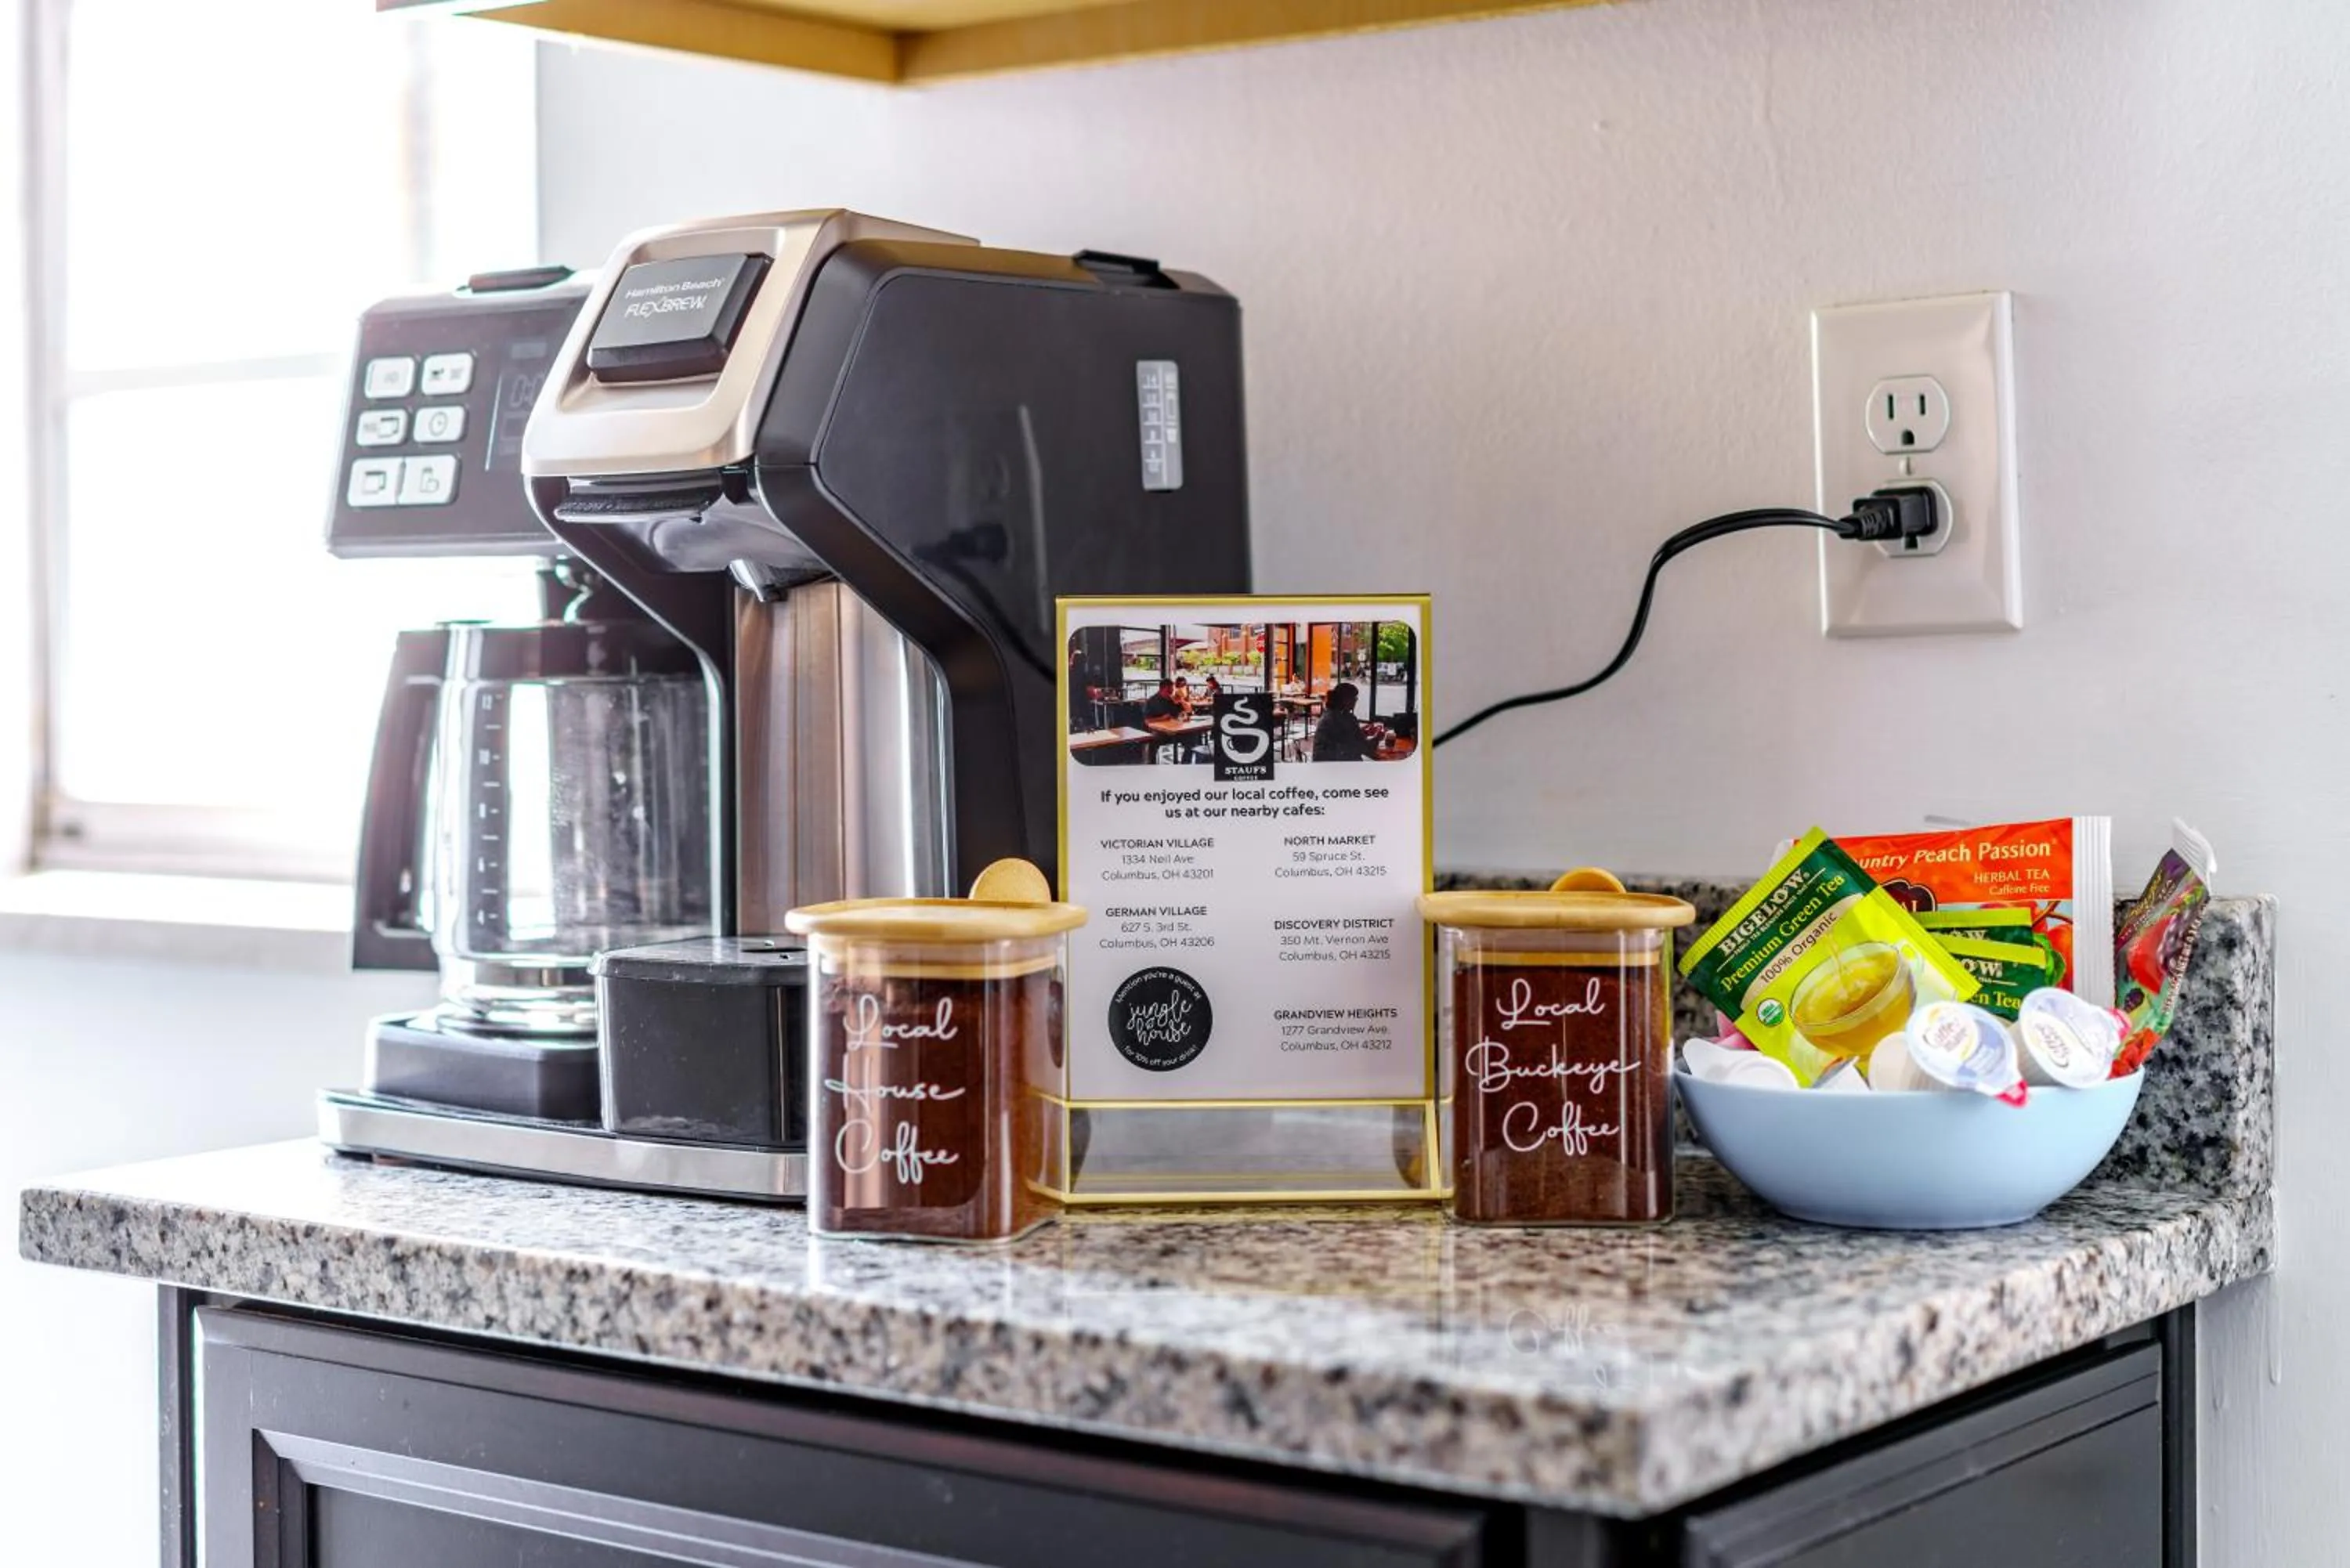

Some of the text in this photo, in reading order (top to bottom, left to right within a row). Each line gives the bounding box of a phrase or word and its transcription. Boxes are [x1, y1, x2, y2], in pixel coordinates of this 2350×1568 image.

[625, 276, 722, 298] Hamilton Beach
[1101, 786, 1390, 805] If you enjoyed our local coffee, come see
[1165, 803, 1325, 820] us at our nearby cafes:
[1101, 837, 1215, 850] VICTORIAN VILLAGE
[1284, 835, 1376, 846] NORTH MARKET
[1123, 854, 1195, 865] 1334 Neil Ave
[1292, 851, 1365, 863] 59 Spruce St.
[1914, 839, 1971, 865] Peach
[1978, 839, 2051, 861] Passion
[1101, 869, 1214, 881] Columbus, OH 43201
[1274, 865, 1387, 877] Columbus, OH 43215
[1974, 868, 2050, 884] HERBAL TEA
[1989, 882, 2050, 896] Caffeine Free
[1105, 906, 1208, 917] GERMAN VILLAGE
[1717, 867, 1808, 958] BIGELOW
[1121, 922, 1141, 933] 627
[1156, 922, 1174, 932] 3rd
[1177, 922, 1192, 931] St.
[1274, 918, 1395, 930] DISCOVERY DISTRICT
[1281, 935, 1301, 945] 350
[1303, 935, 1323, 945] Mt.
[1325, 935, 1365, 945] Vernon
[1721, 935, 1784, 992] Premium
[1778, 897, 1823, 938] Green
[1817, 874, 1846, 898] Tea
[1099, 936, 1215, 949] Columbus, OH 43206
[1762, 955, 1793, 985] 100%
[1791, 911, 1838, 958] Organic
[1279, 948, 1391, 962] Columbus, OH 43215
[1495, 977, 1606, 1031] Local
[1993, 991, 2020, 1009] Tea
[1126, 989, 1193, 1030] jungle
[1274, 1008, 1398, 1020] GRANDVIEW HEIGHTS
[842, 994, 959, 1051] Local
[1282, 1025, 1304, 1036] 1277
[1307, 1024, 1365, 1035] Grandview
[1137, 1017, 1191, 1046] house
[1280, 1039, 1393, 1052] Columbus, OH 43212
[1465, 1035, 1642, 1094] Buckeye
[824, 1052, 966, 1113] House
[1502, 1100, 1621, 1156] Coffee
[835, 1118, 960, 1184] Coffee
